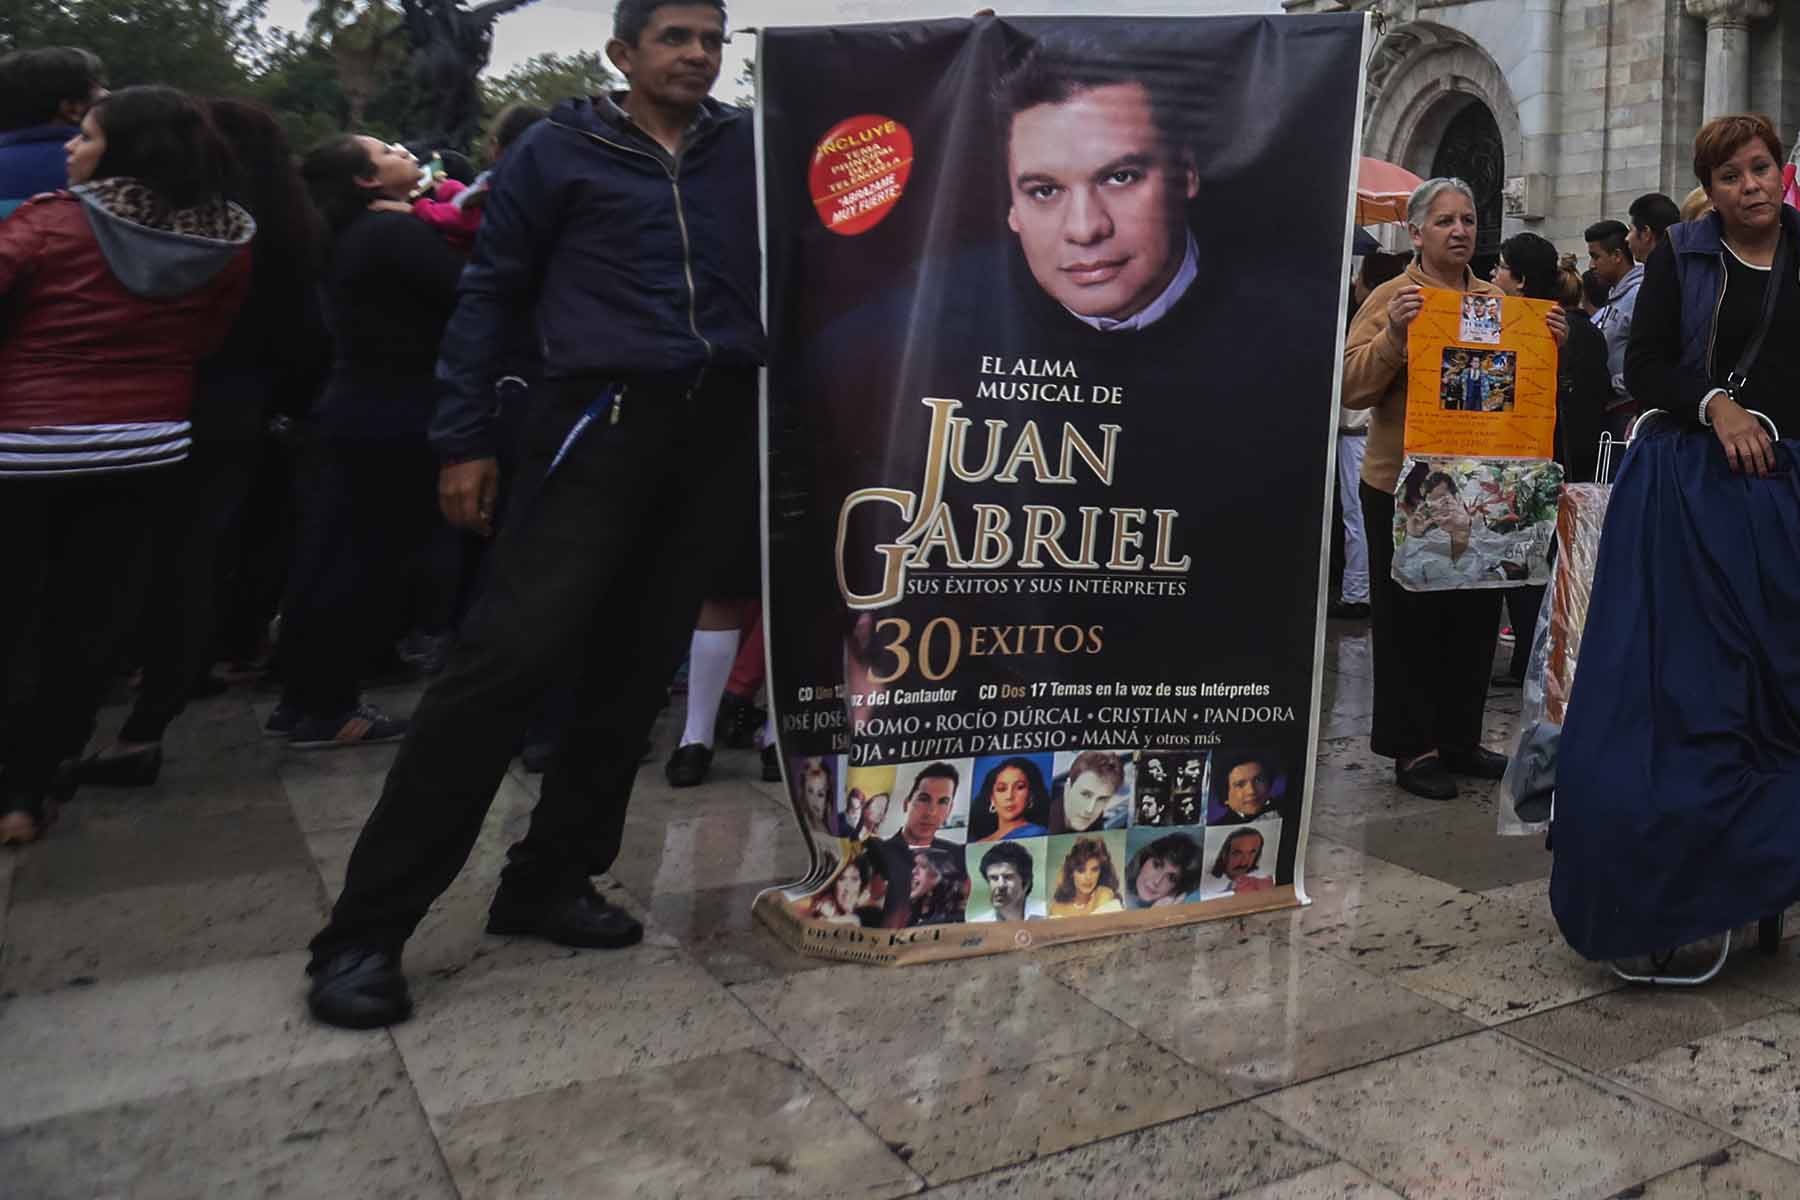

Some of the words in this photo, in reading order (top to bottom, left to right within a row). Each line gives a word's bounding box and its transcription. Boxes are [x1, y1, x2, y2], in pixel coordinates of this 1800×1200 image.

[817, 120, 896, 155] INCLUYE
[981, 355, 1006, 375] EL
[1011, 358, 1078, 378] ALMA
[976, 381, 1085, 403] MUSICAL
[1092, 385, 1123, 405] DE
[896, 397, 1122, 545] JUAN
[834, 487, 1192, 610] GABRIEL
[906, 578, 939, 595] SUS
[945, 575, 1009, 595] ÉXITOS
[1012, 578, 1025, 593] Y
[1029, 578, 1062, 595] SUS
[1069, 575, 1187, 596] INTÉRPRETES
[866, 616, 961, 683] 30
[969, 623, 1104, 656] EXITOS
[867, 690, 889, 706] del
[894, 687, 957, 705] Cantautor
[979, 684, 998, 700] CD
[1001, 683, 1026, 698] Dos
[1030, 682, 1047, 697] 17
[1050, 682, 1092, 697] Temas
[1095, 684, 1112, 697] en
[1115, 682, 1128, 696] la
[1131, 684, 1153, 697] voz
[1156, 682, 1171, 697] de
[1175, 684, 1197, 697] sus
[1200, 681, 1270, 698] Intérpretes
[854, 715, 920, 737] ROMO
[936, 708, 997, 732] ROCÍO
[1003, 705, 1082, 727] DÚRCAL
[1098, 706, 1187, 724] CRISTIAN
[1203, 705, 1296, 723] PANDORA
[901, 736, 964, 758] LUPITA
[1081, 726, 1140, 745] MANÁ
[1156, 733, 1191, 745] otros
[1194, 730, 1222, 744] más
